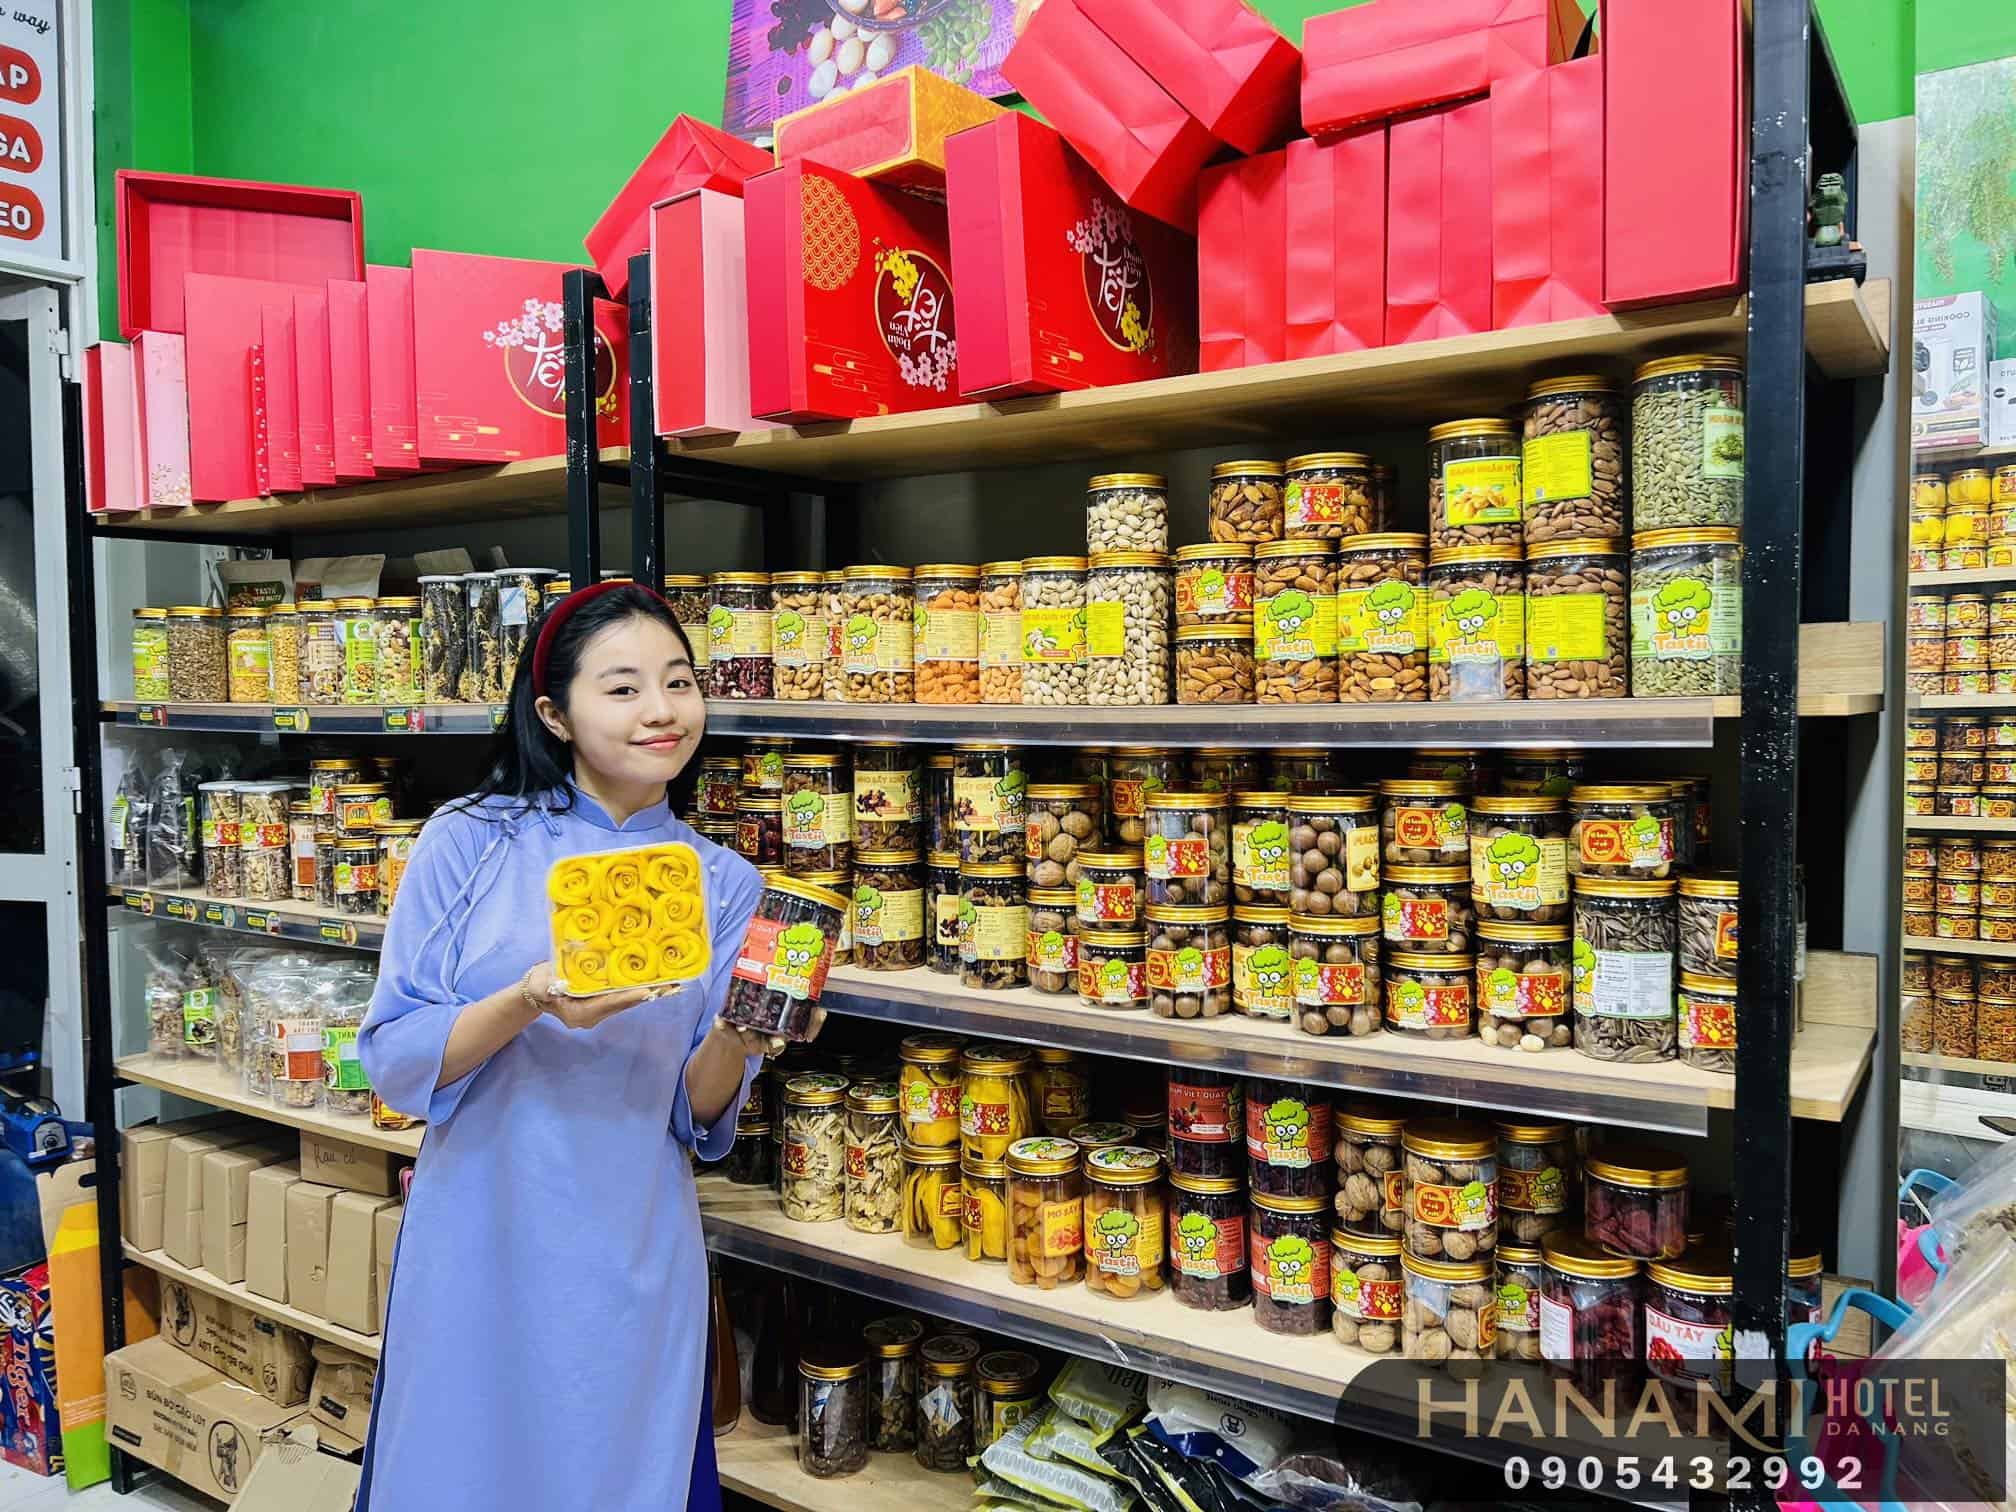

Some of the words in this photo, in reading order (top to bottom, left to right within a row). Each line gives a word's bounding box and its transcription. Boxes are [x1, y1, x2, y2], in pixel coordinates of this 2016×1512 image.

[13, 11, 51, 34] way
[1093, 241, 1138, 328] Tết
[892, 272, 948, 353] Tết
[888, 334, 912, 351] Đoàn
[1654, 634, 1709, 651] Tastii
[786, 829, 824, 841] Tastii
[1096, 1250, 1137, 1267] Tastii
[1675, 1327, 1705, 1342] TÂY
[7, 1339, 35, 1426] Tiger
